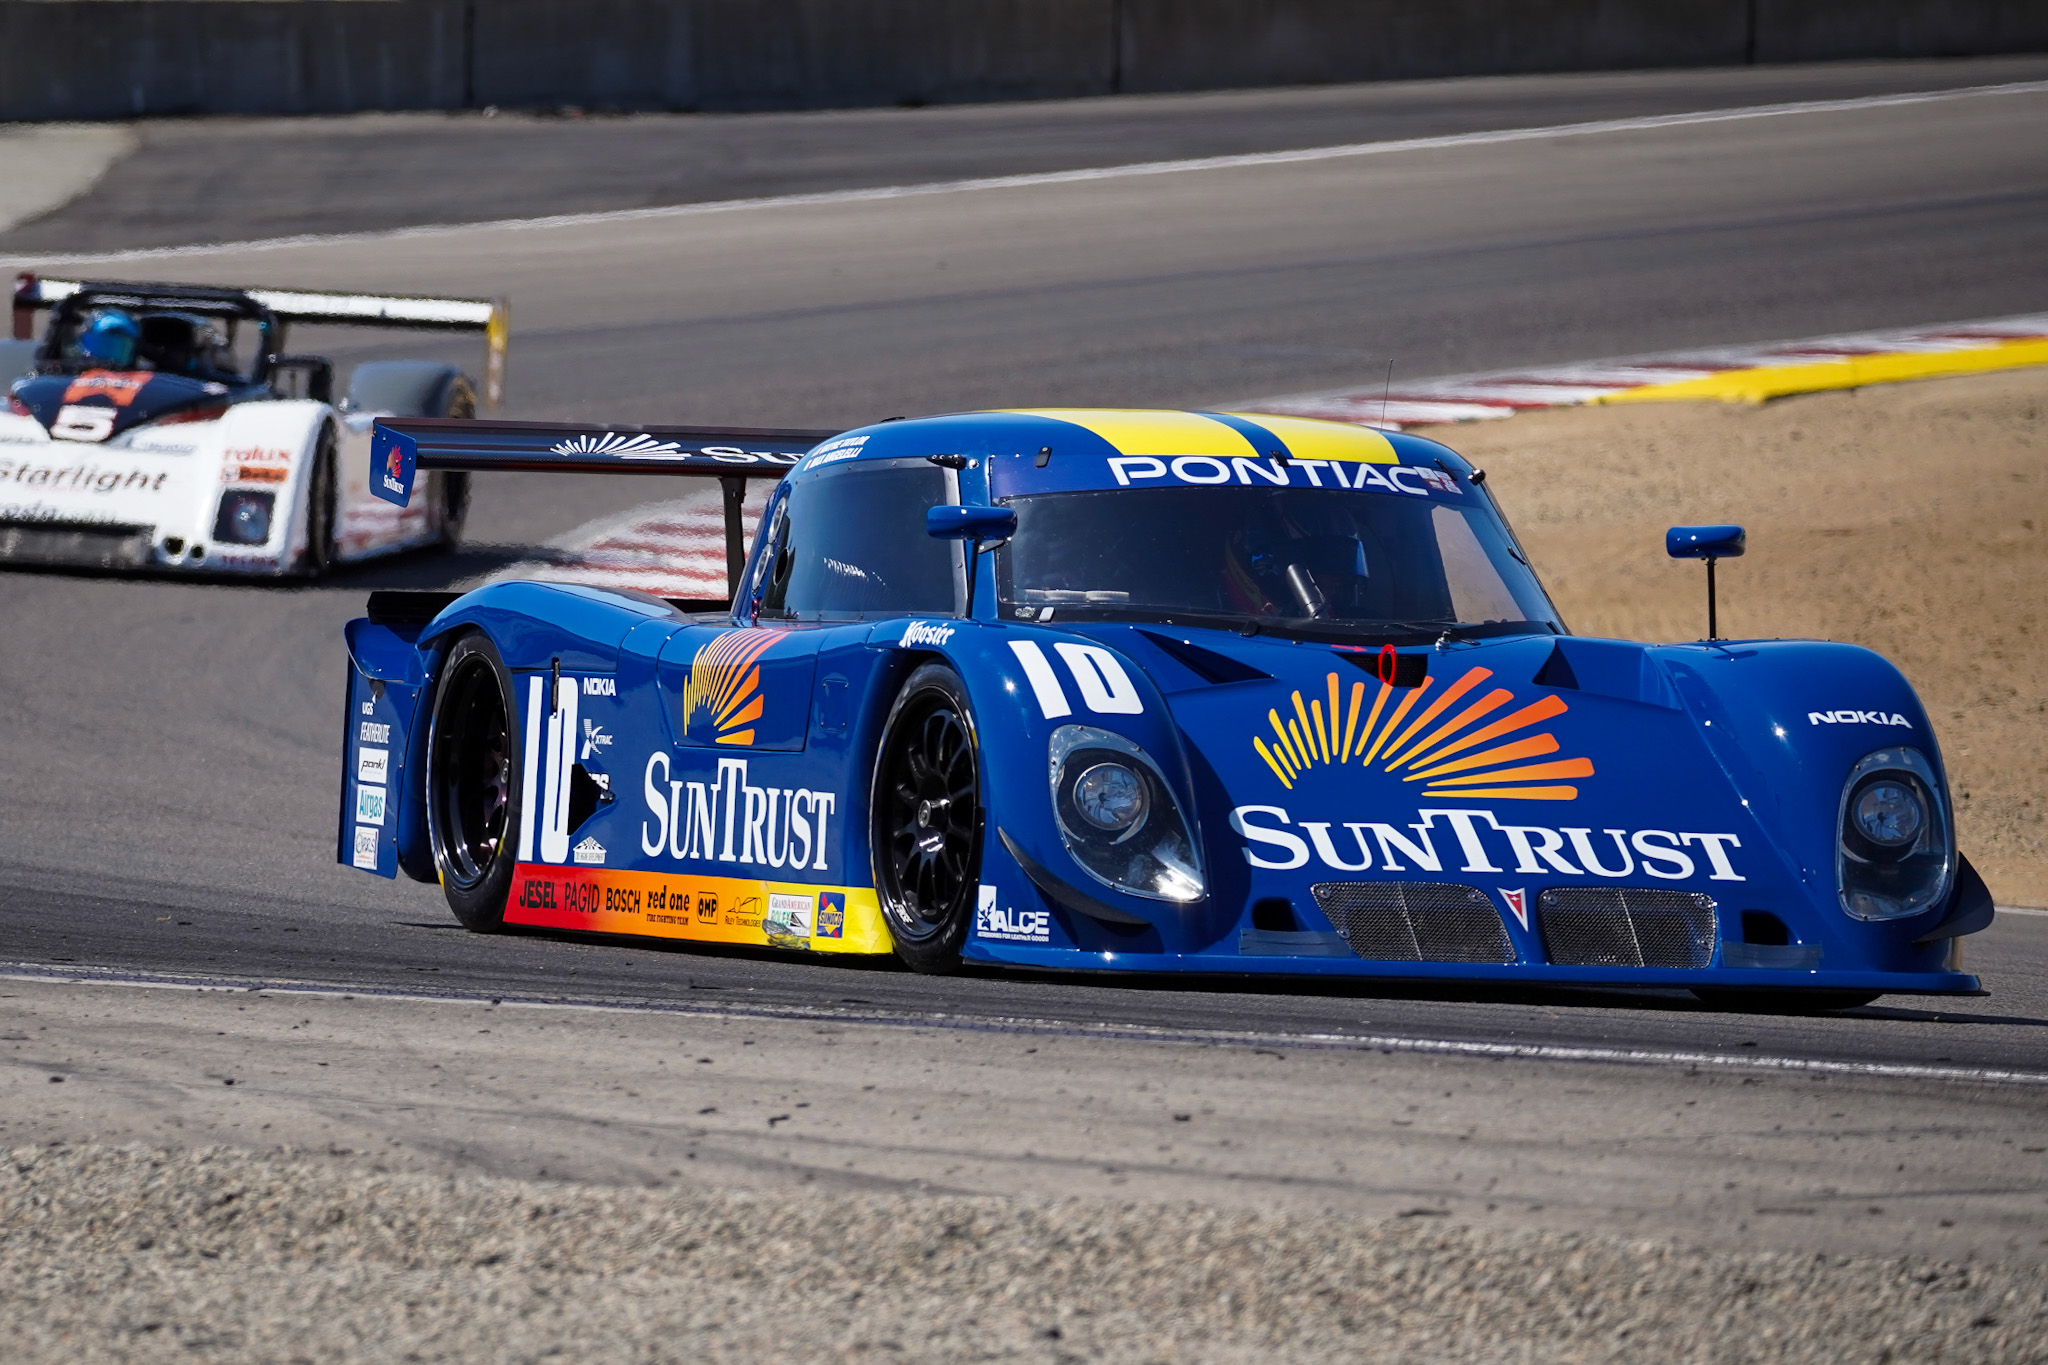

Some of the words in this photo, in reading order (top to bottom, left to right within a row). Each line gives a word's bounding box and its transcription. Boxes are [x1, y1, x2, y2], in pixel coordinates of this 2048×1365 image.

[1106, 456, 1429, 496] PONTIAC
[899, 620, 955, 648] Hoosier
[584, 677, 616, 697] NOKIA
[1008, 640, 1144, 719] 10
[362, 701, 374, 715] UGS
[1807, 710, 1913, 730] NOKIA
[360, 722, 390, 744] FEATHERLITE
[595, 734, 613, 746] XTRAC
[518, 676, 578, 863] 10
[360, 789, 383, 819] Airgas
[519, 880, 558, 909] JESEL
[564, 881, 600, 913] PAGID
[606, 887, 641, 914] BOSCH
[647, 885, 668, 910] red
[669, 892, 690, 912] one
[698, 898, 717, 918] OMP
[677, 916, 689, 926] TEAM
[819, 912, 842, 926] SUNOCO
[990, 907, 1050, 935] ALCE
